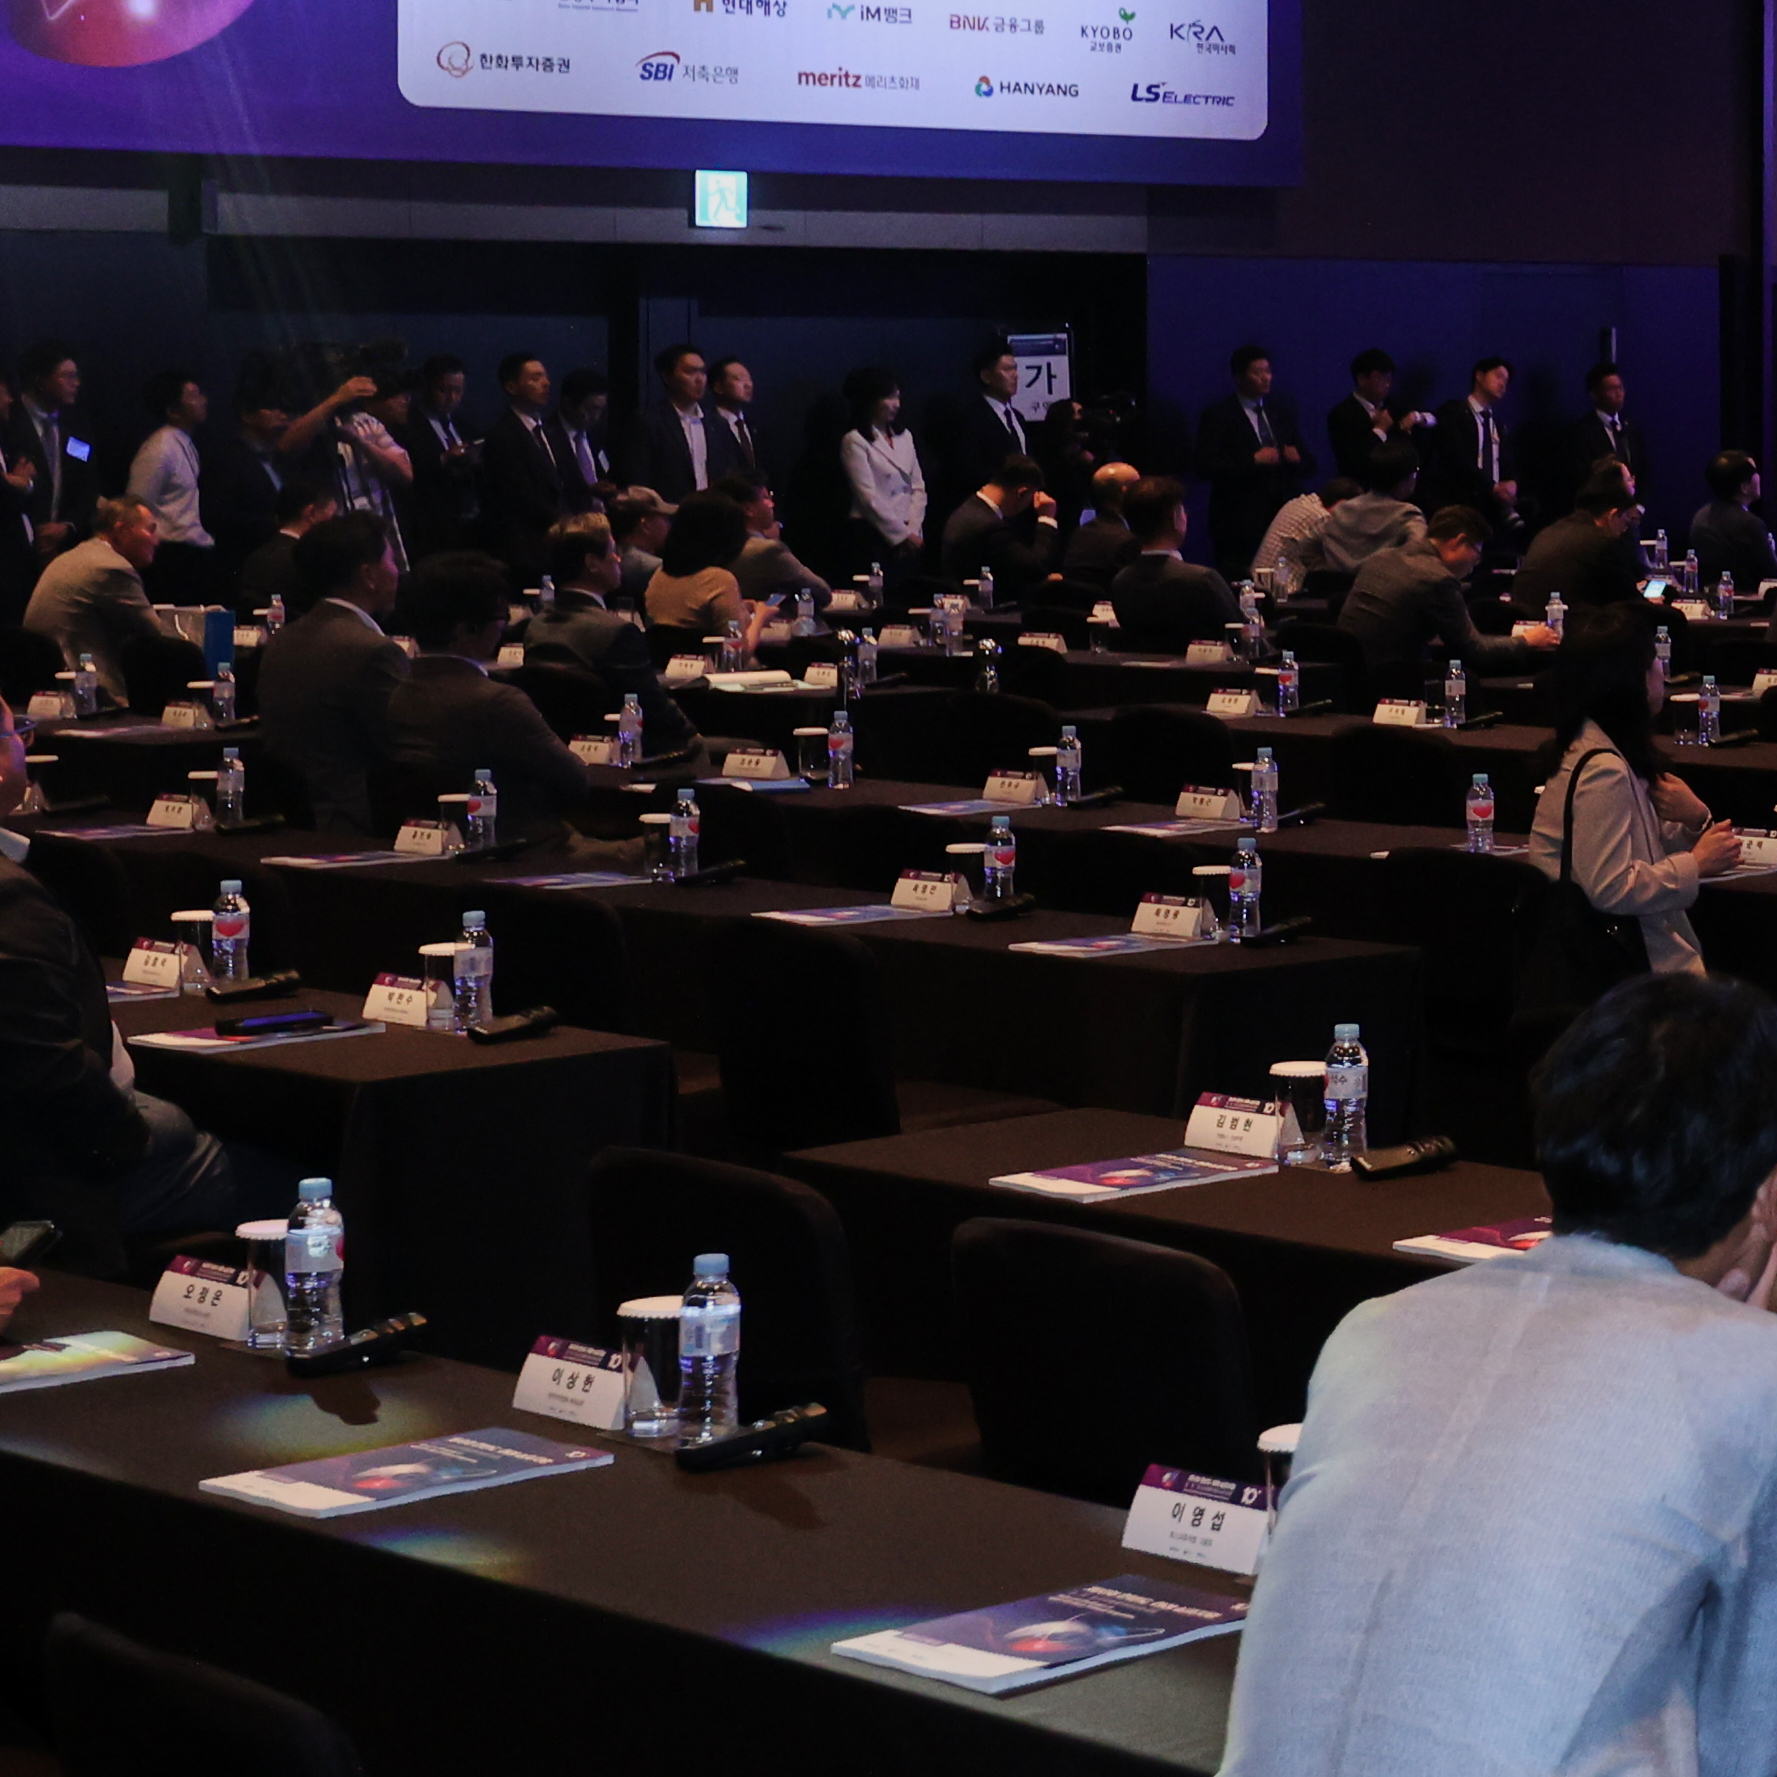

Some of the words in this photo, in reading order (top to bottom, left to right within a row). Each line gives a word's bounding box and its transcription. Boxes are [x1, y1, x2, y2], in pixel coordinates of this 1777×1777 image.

[949, 14, 990, 33] BNK
[1080, 24, 1133, 42] KYOBO
[1169, 20, 1226, 43] KRA
[480, 52, 571, 74] 한화투자증권
[639, 61, 674, 83] SBI
[682, 64, 739, 84] 저축은행
[797, 67, 863, 90] meritz
[1000, 80, 1080, 98] HANYANG
[1131, 83, 1160, 103] LS
[1161, 91, 1236, 108] ELECTRIC
[1025, 361, 1057, 395] 가
